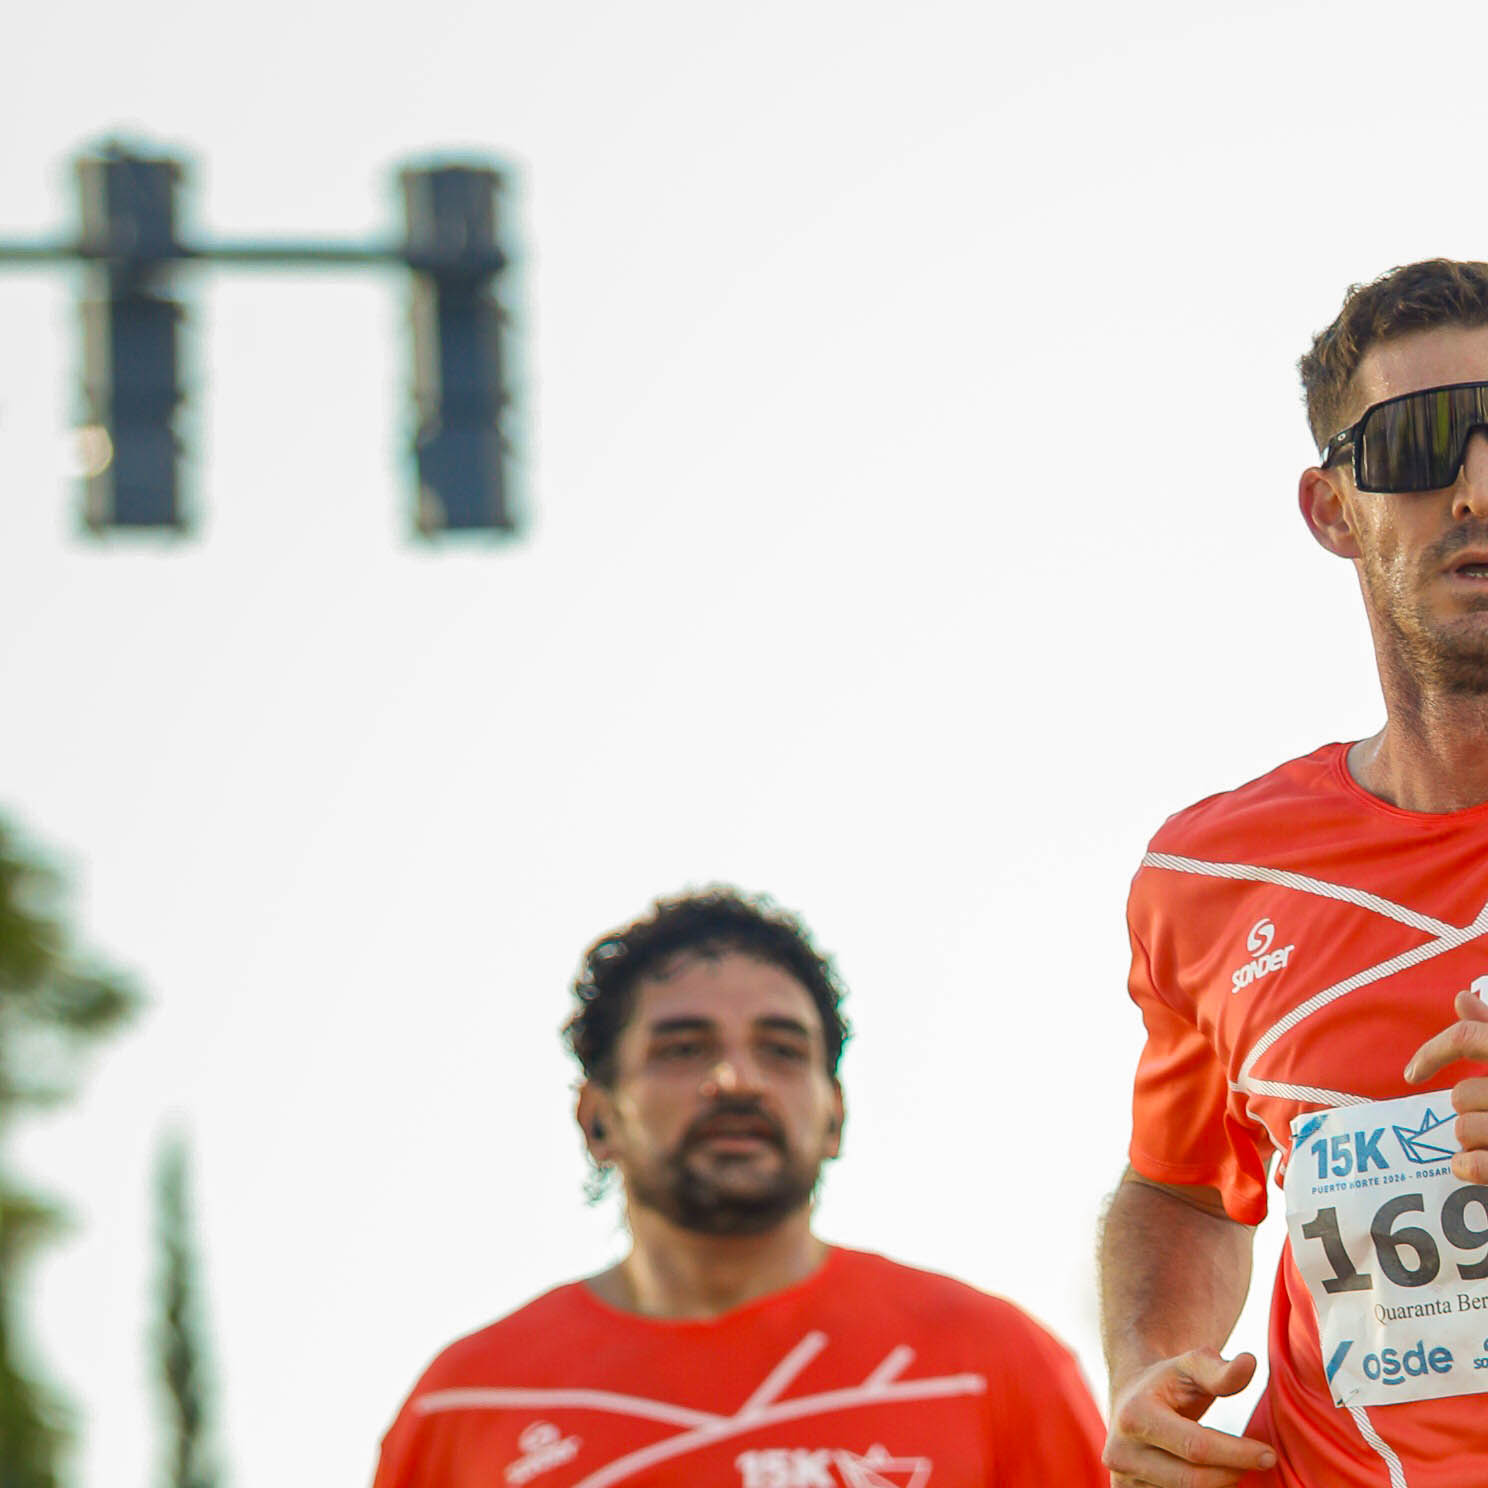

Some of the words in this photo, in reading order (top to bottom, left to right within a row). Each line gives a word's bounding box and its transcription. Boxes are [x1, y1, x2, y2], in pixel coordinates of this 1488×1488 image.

[1311, 1127, 1390, 1179] 15K
[1311, 1181, 1347, 1195] PUERTO
[1416, 1166, 1452, 1179] ROSARI
[1374, 1298, 1452, 1325] Quaranta
[1362, 1339, 1455, 1386] osde
